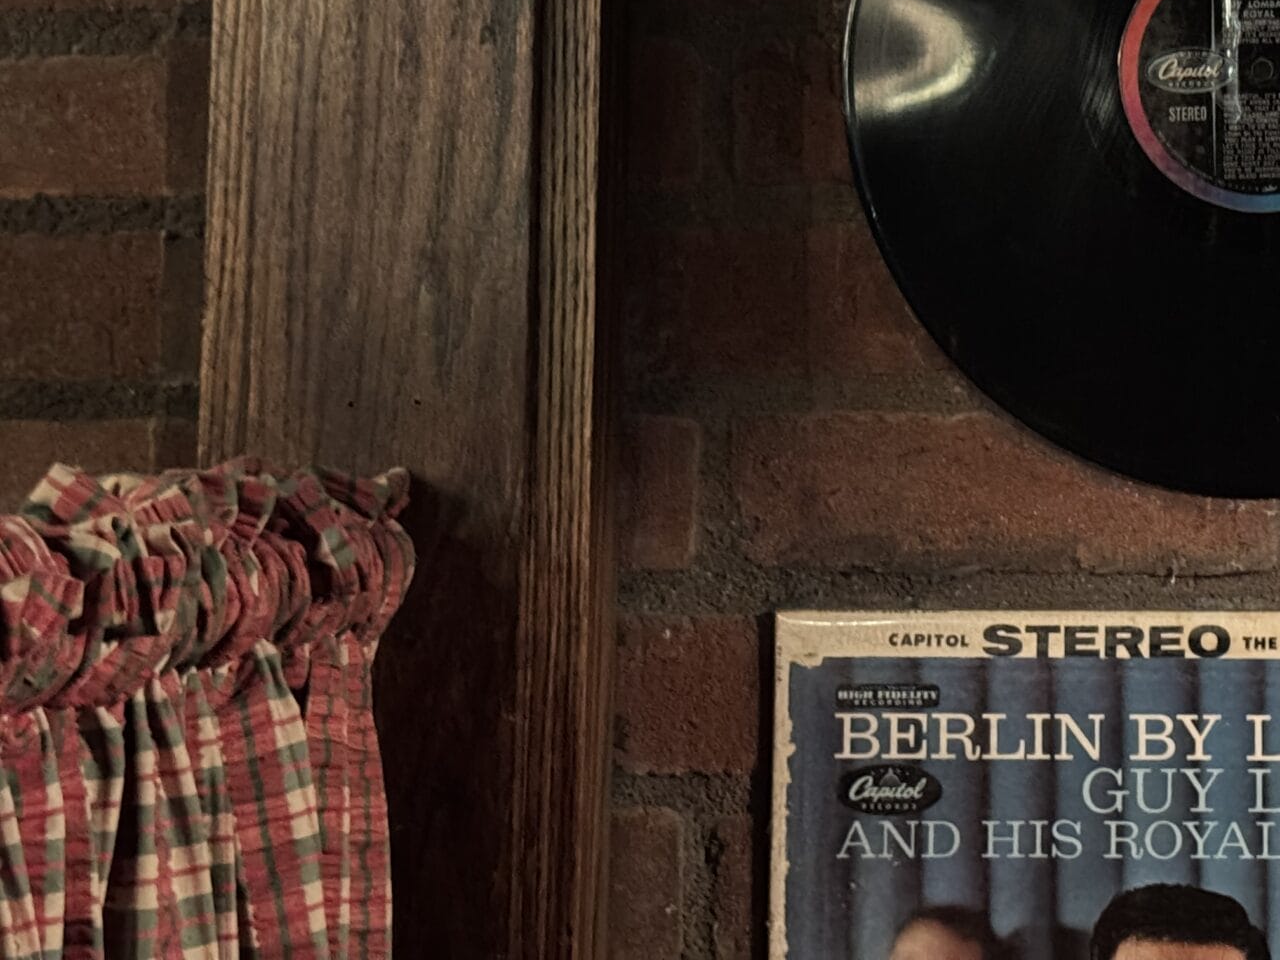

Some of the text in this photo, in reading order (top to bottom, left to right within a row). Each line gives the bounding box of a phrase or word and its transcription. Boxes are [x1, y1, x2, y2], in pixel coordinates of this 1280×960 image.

[1243, 9, 1275, 18] ROYAL
[1158, 57, 1223, 81] Capitol
[1168, 105, 1207, 122] STEREO
[888, 632, 970, 648] CAPITOL
[981, 624, 1232, 659] STEREO
[1242, 636, 1278, 651] THE
[833, 712, 1105, 761] BERLIN
[1128, 713, 1222, 761] BY
[848, 775, 928, 803] Capitol
[1082, 767, 1225, 815] GUY
[836, 820, 961, 860] AND
[980, 819, 1083, 860] HIS
